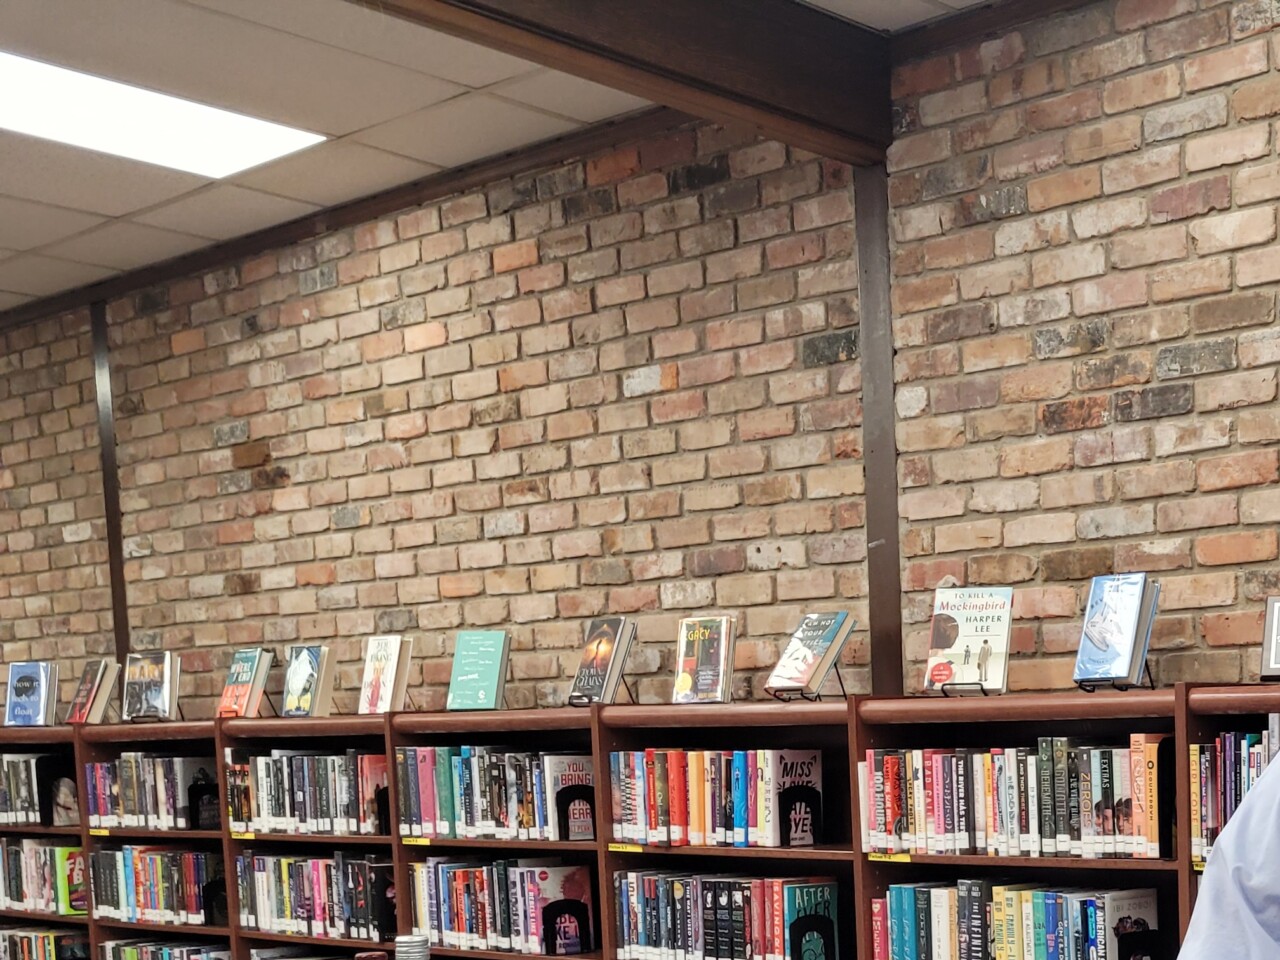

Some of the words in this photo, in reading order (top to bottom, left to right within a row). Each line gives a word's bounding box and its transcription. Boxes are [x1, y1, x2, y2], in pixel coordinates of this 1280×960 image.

[939, 601, 1006, 612] Mockingbird
[965, 615, 1002, 623] HARPER
[974, 625, 991, 633] LEE
[14, 680, 30, 688] how
[14, 707, 33, 715] float
[566, 762, 584, 772] YOU
[782, 761, 814, 778] MISS
[924, 760, 932, 783] BAD
[1101, 759, 1110, 788] EXTRAS
[560, 773, 592, 785] BRING
[874, 771, 883, 789] 100
[1041, 770, 1052, 815] BEHEMOTH
[1056, 768, 1065, 814] GOLIATH
[1081, 772, 1091, 828] ZEROES
[875, 793, 885, 832] HOURS
[795, 887, 830, 909] AFTER
[960, 919, 968, 932] THE
[1006, 913, 1015, 945] FRANKLY
[1096, 910, 1106, 957] AMERICAN
